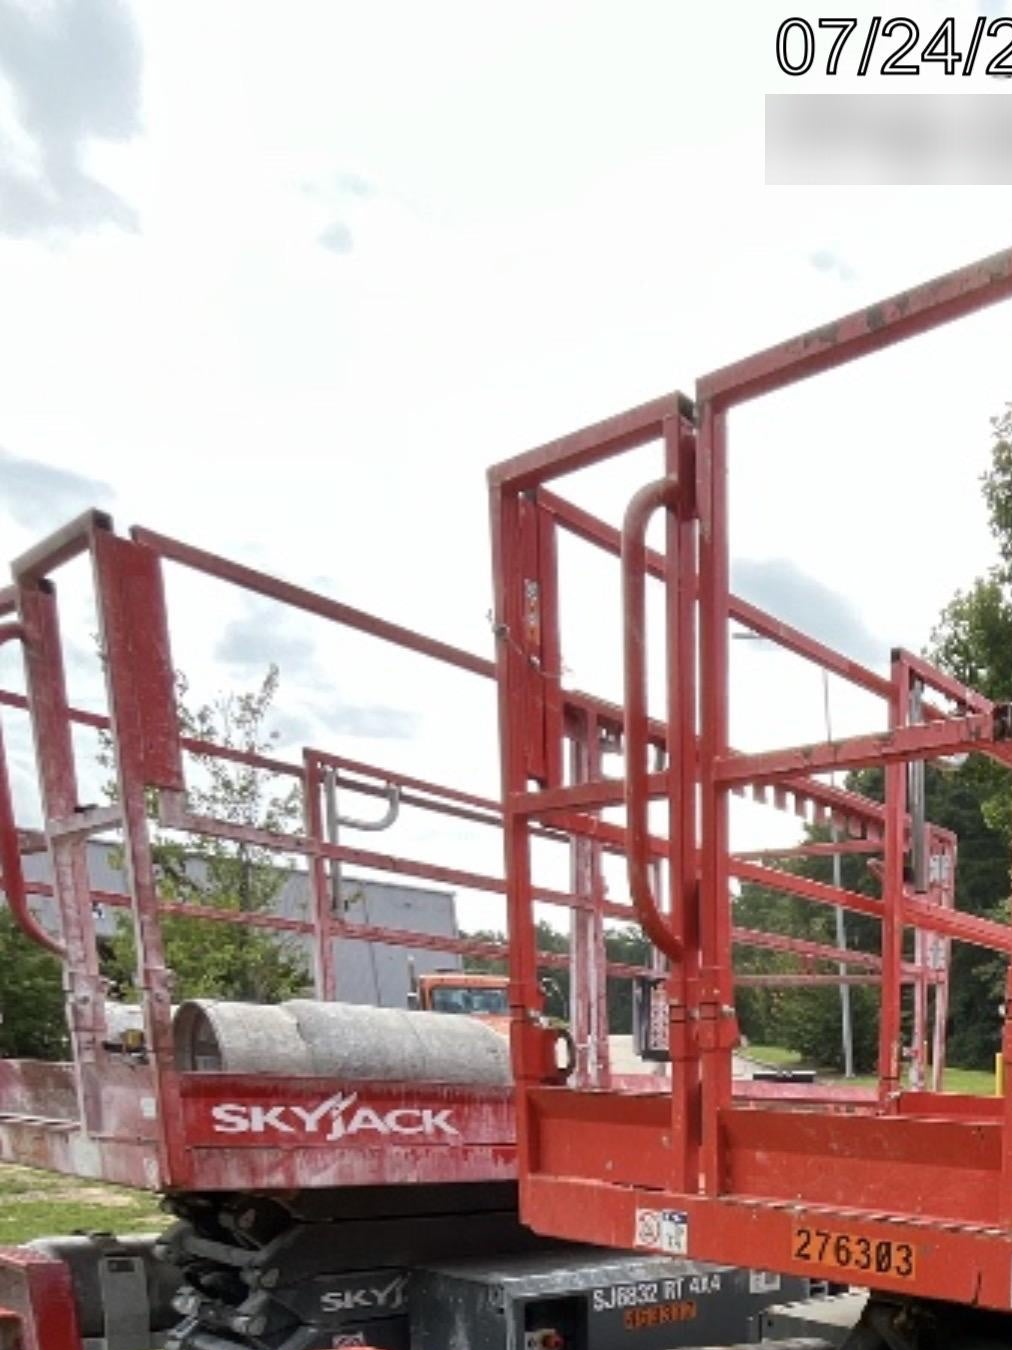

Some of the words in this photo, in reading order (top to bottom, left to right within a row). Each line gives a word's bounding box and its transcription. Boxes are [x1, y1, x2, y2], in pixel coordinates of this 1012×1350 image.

[211, 1091, 460, 1141] SKYJACK
[793, 1229, 914, 1278] 276303
[319, 1273, 411, 1312] SKYJ
[592, 1282, 659, 1312] SJ6832
[664, 1278, 685, 1300] RT
